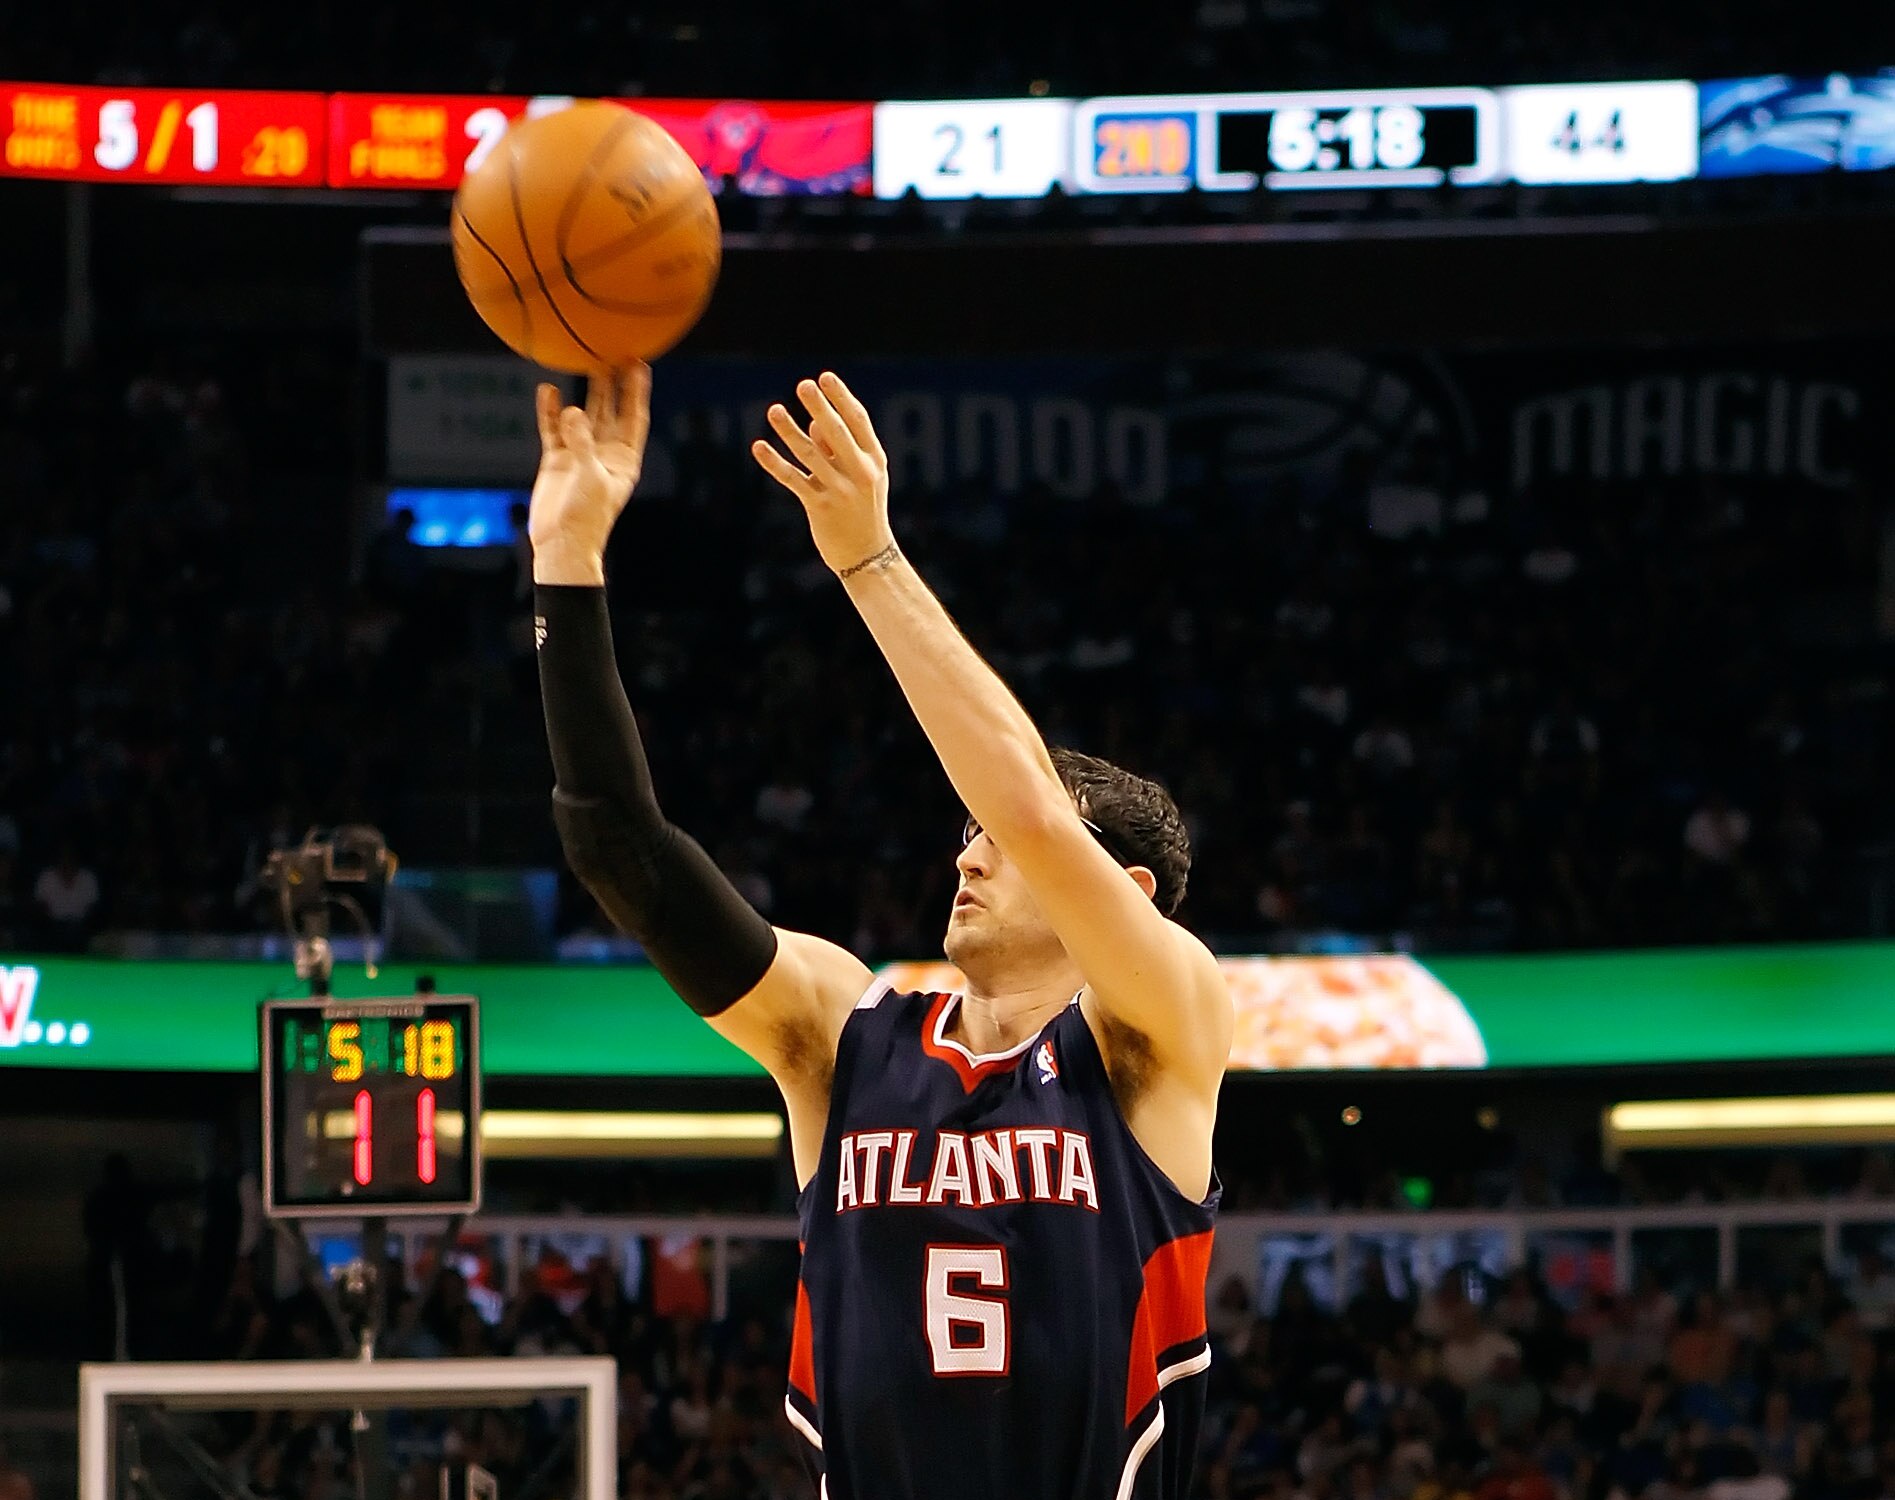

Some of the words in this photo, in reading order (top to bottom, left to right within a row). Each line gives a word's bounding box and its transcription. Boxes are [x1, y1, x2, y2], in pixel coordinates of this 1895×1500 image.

[934, 121, 1004, 176] 21
[1550, 108, 1626, 157] 44
[1511, 370, 1860, 493] MAGIC
[836, 1126, 1100, 1214] ATLANTA
[922, 1242, 1011, 1378] 6
